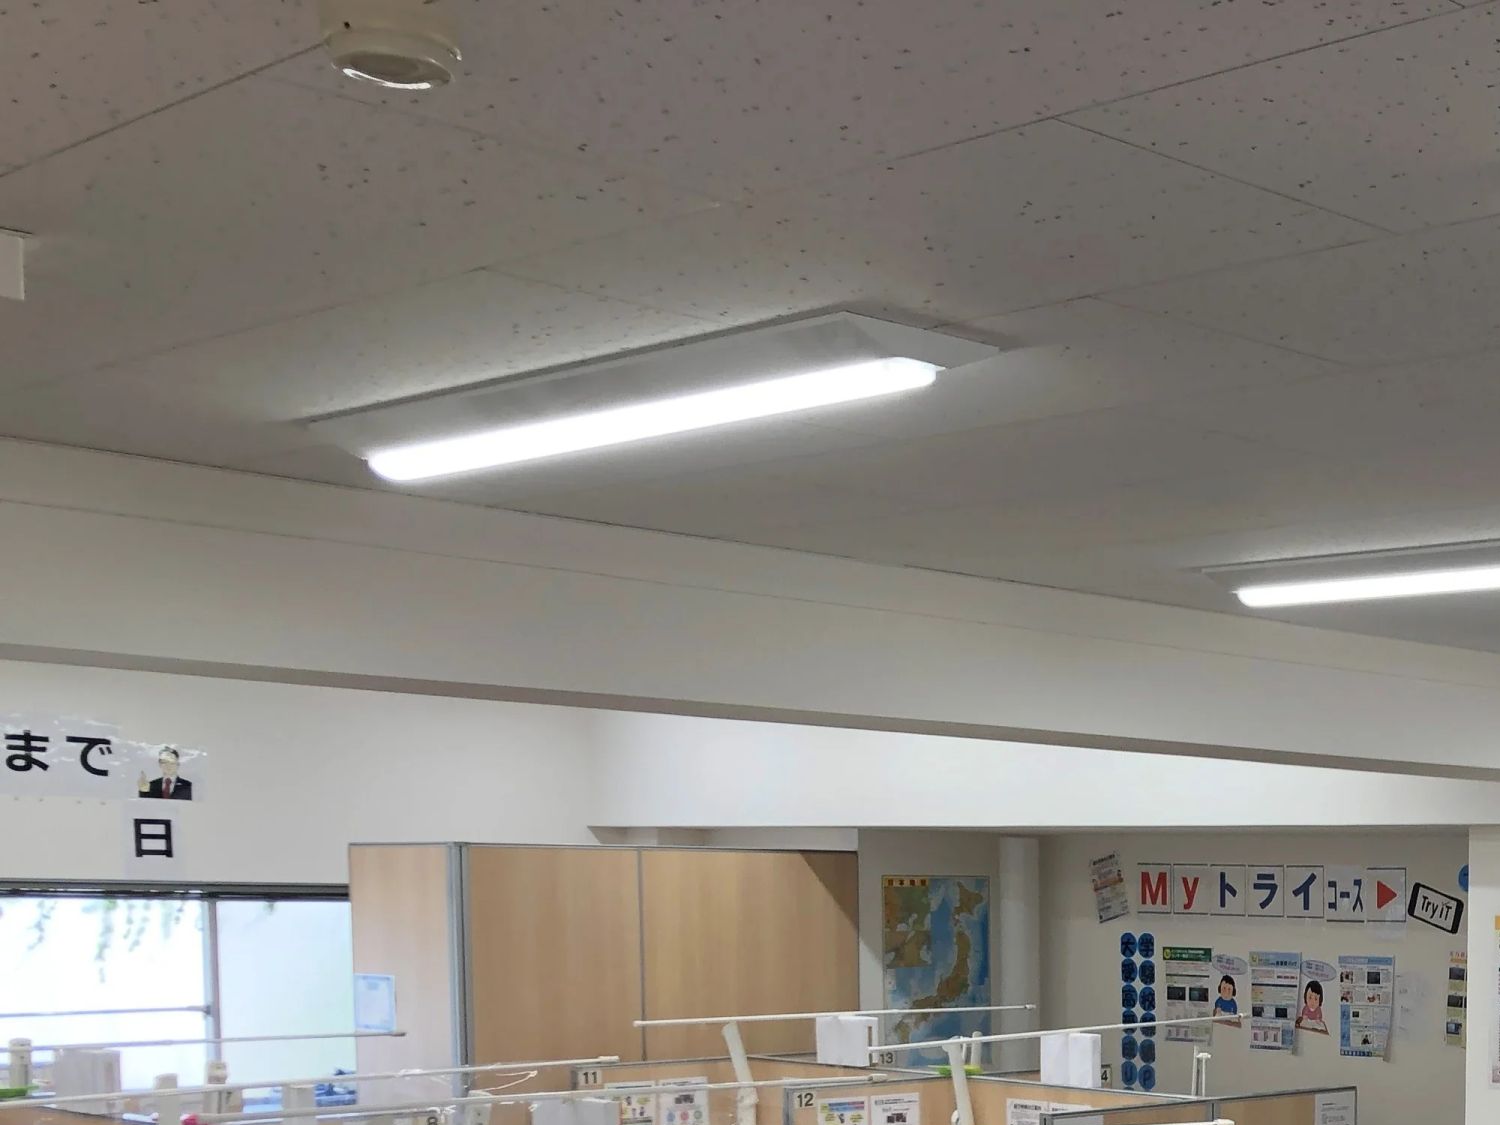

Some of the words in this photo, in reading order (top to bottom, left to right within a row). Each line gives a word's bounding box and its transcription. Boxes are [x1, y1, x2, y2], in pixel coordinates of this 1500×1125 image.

[5, 730, 112, 776] まで
[134, 818, 173, 858] 日
[880, 1052, 893, 1064] 13
[583, 1071, 598, 1084] 11
[797, 1092, 814, 1107] 12
